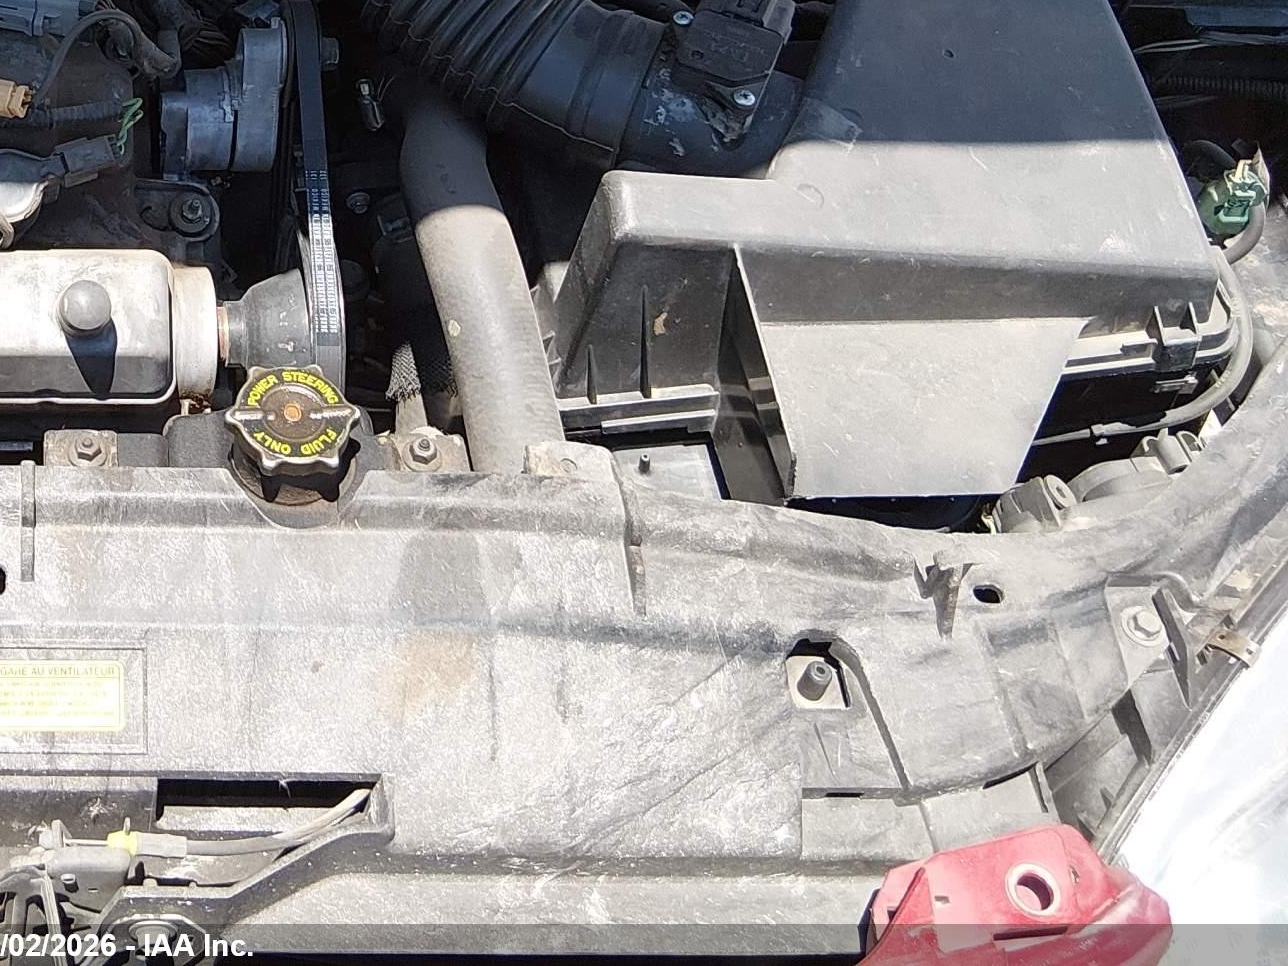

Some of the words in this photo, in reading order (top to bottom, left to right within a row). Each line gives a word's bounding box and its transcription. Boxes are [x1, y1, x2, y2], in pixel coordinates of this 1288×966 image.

[247, 374, 279, 406] POWER
[281, 371, 339, 405] STEERING
[253, 431, 292, 455] ONLY
[300, 428, 337, 455] FLUID
[0, 666, 28, 675] GARE
[31, 667, 45, 675] AU
